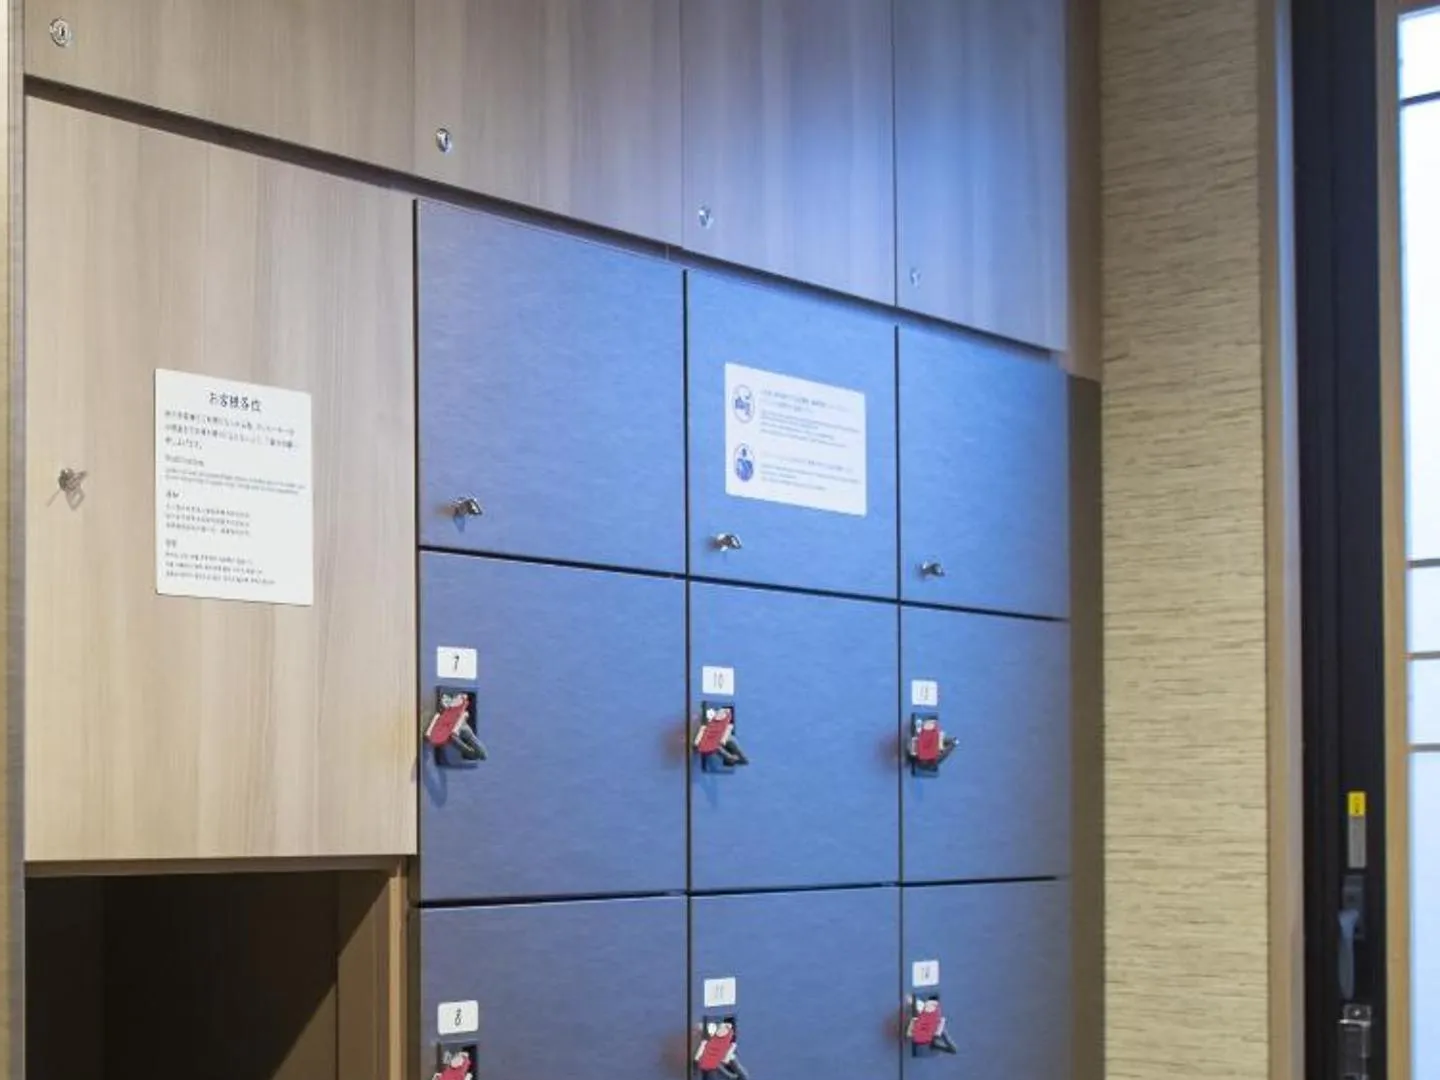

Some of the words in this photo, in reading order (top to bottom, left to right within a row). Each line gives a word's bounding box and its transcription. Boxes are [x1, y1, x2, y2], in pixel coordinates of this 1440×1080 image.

[208, 392, 262, 413] お客様各位
[713, 671, 725, 690] 10
[454, 1007, 462, 1027] 8
